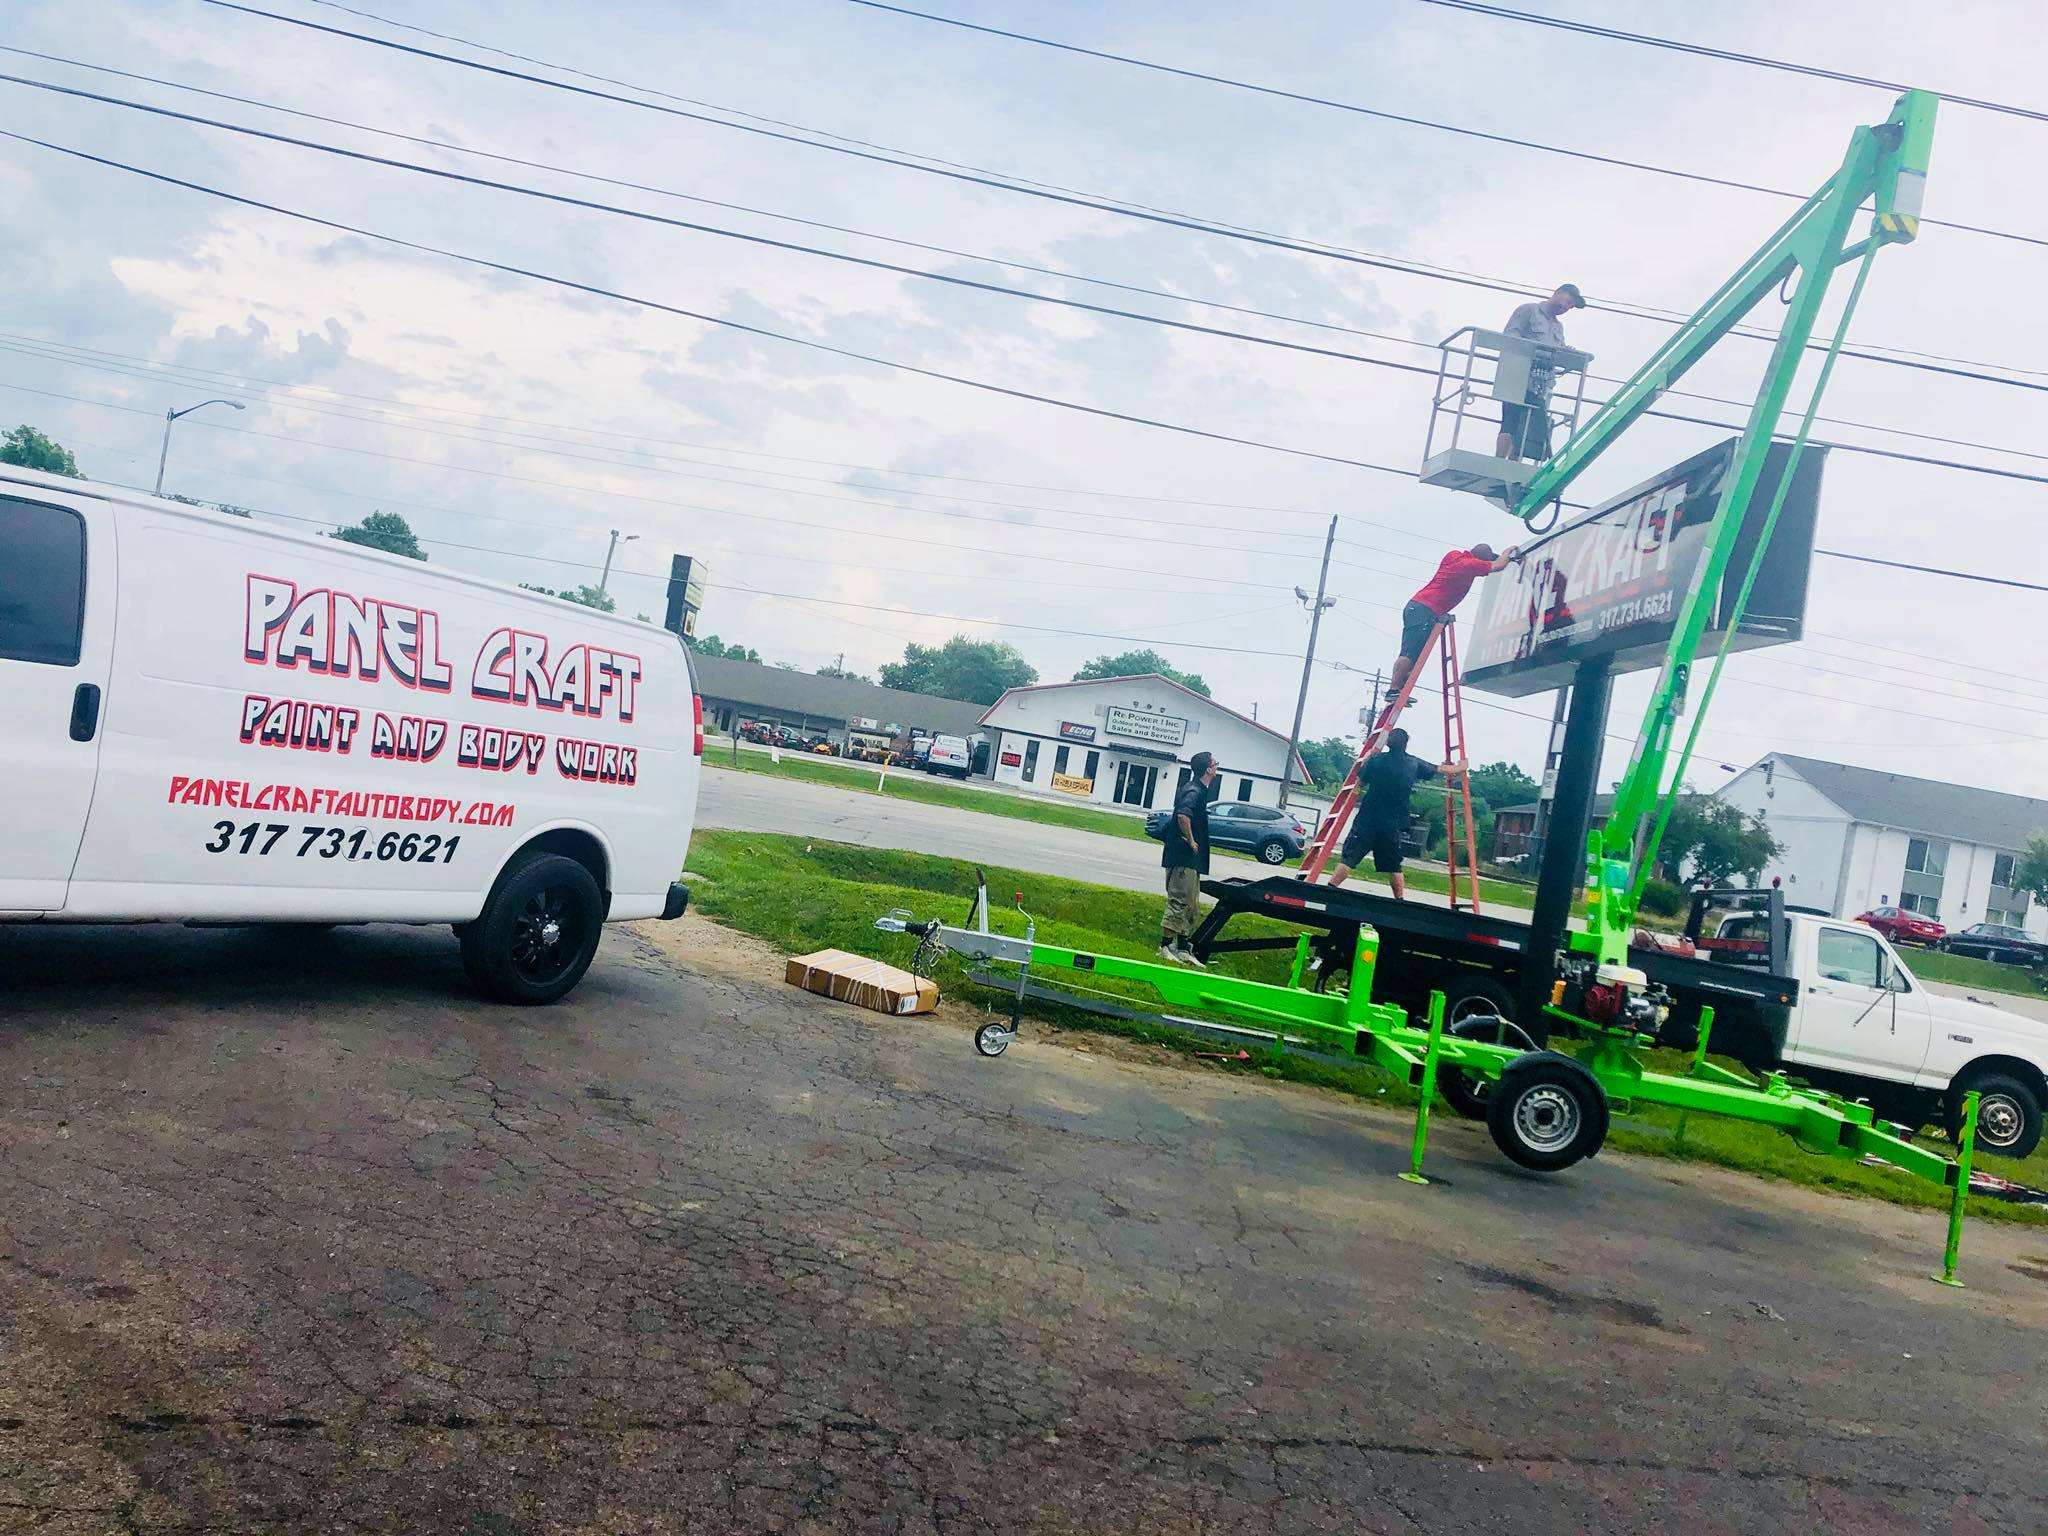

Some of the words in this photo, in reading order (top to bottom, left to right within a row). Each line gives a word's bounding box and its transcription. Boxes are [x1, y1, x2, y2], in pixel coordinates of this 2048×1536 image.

[1598, 591, 1674, 630] 317.731.6621
[244, 573, 452, 693] PANEL
[471, 627, 641, 723] CRAFT
[239, 695, 359, 753] PAINT
[370, 712, 447, 763] AND
[457, 724, 545, 774] BODY
[556, 739, 638, 785] WORK
[1068, 726, 1095, 736] ECHO
[1111, 725, 1132, 733] Sales
[1150, 731, 1179, 741] Service
[167, 776, 514, 827] PANELCRAFTAUTOBODY.COM
[205, 820, 288, 856] 317
[295, 827, 461, 864] 731.6621
